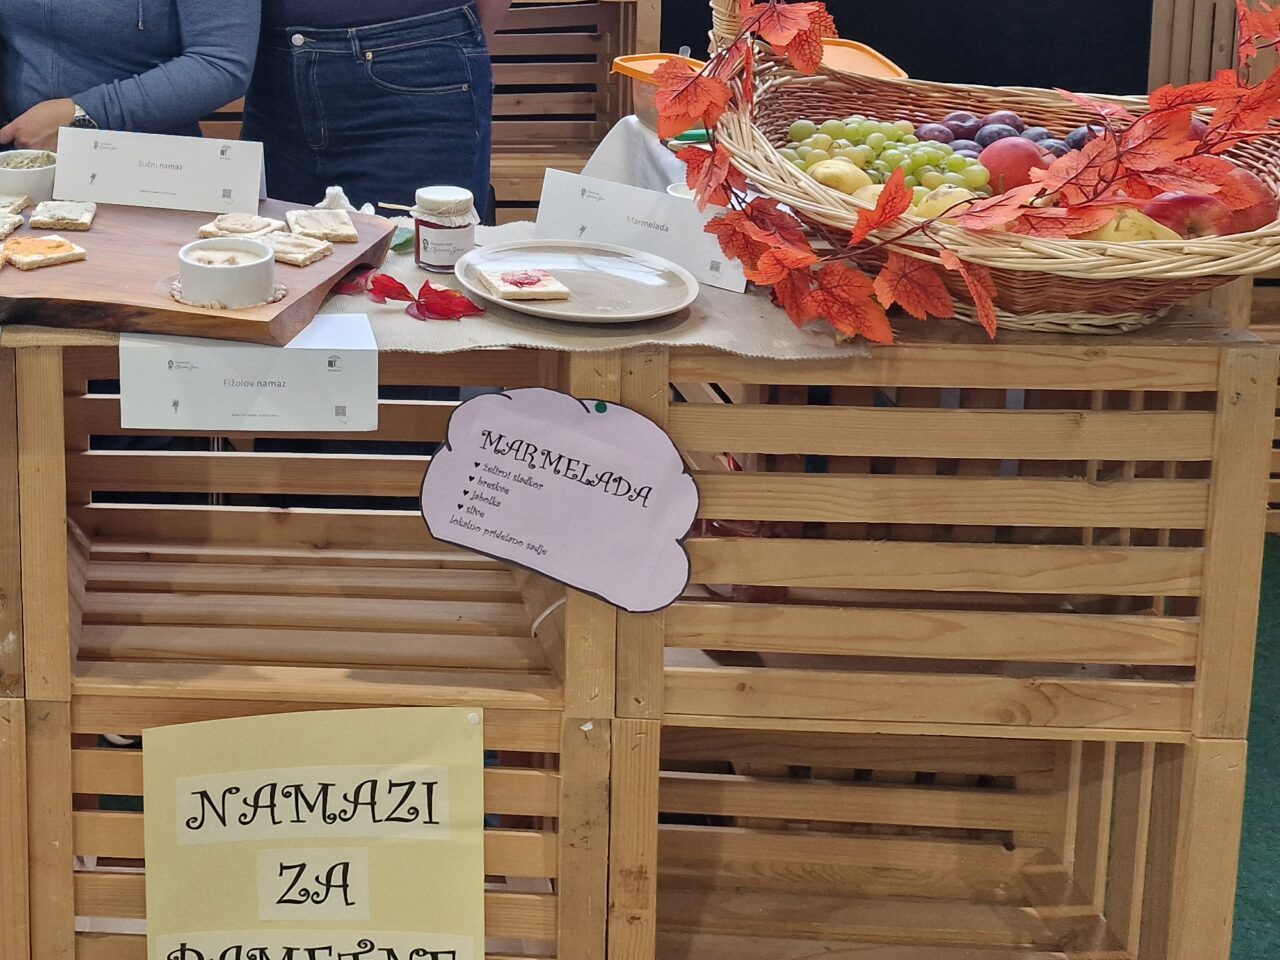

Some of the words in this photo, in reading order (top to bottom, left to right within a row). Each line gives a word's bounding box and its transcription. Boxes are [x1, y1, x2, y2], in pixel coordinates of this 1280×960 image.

[626, 216, 669, 232] Marmelada
[256, 380, 286, 388] namaz
[480, 429, 652, 508] MARMELADA
[476, 476, 510, 494] breskve
[512, 473, 544, 490] sladkor
[470, 490, 502, 508] jabolka
[466, 505, 486, 518] slive
[482, 528, 524, 546] pridelano
[526, 542, 548, 556] sadje
[185, 779, 440, 830] NAMAZI
[276, 862, 356, 906] ZA
